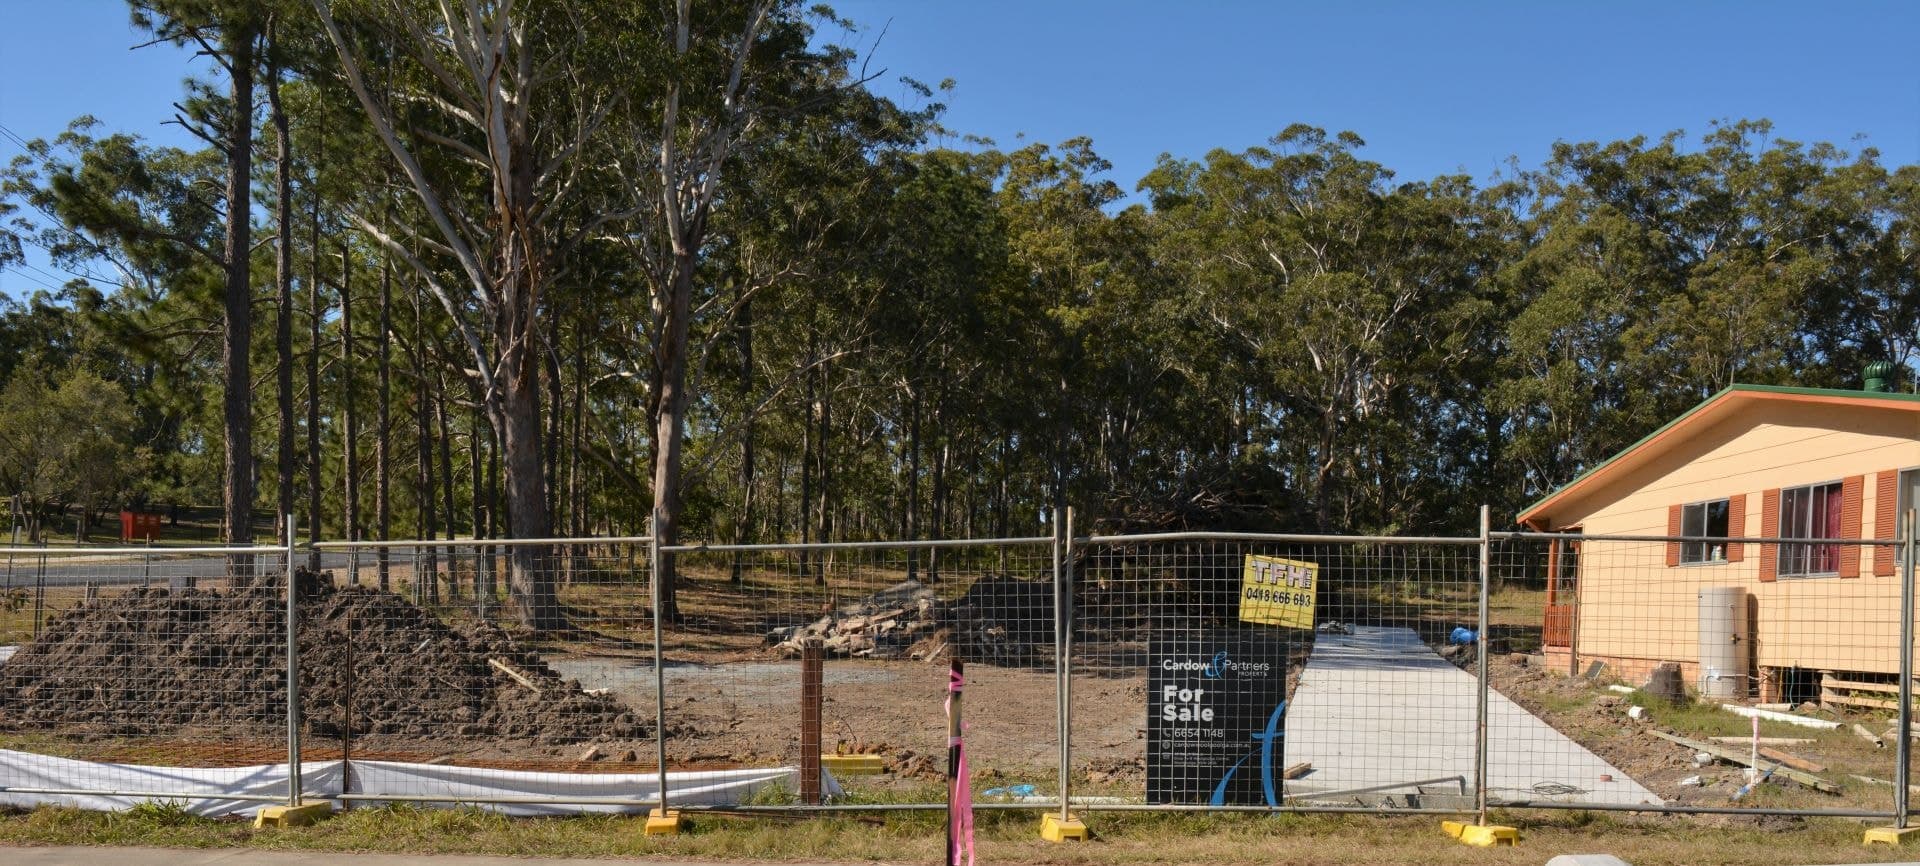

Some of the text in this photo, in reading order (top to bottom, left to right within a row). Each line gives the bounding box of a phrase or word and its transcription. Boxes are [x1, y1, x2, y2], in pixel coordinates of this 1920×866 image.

[1250, 560, 1305, 588] TFH
[1246, 587, 1311, 608] 0418 666 693
[1162, 659, 1210, 671] Cardow
[1224, 659, 1270, 671] Partners
[1163, 685, 1204, 702] For
[1162, 703, 1215, 721] Sale
[1174, 728, 1224, 738] 6654 1148
